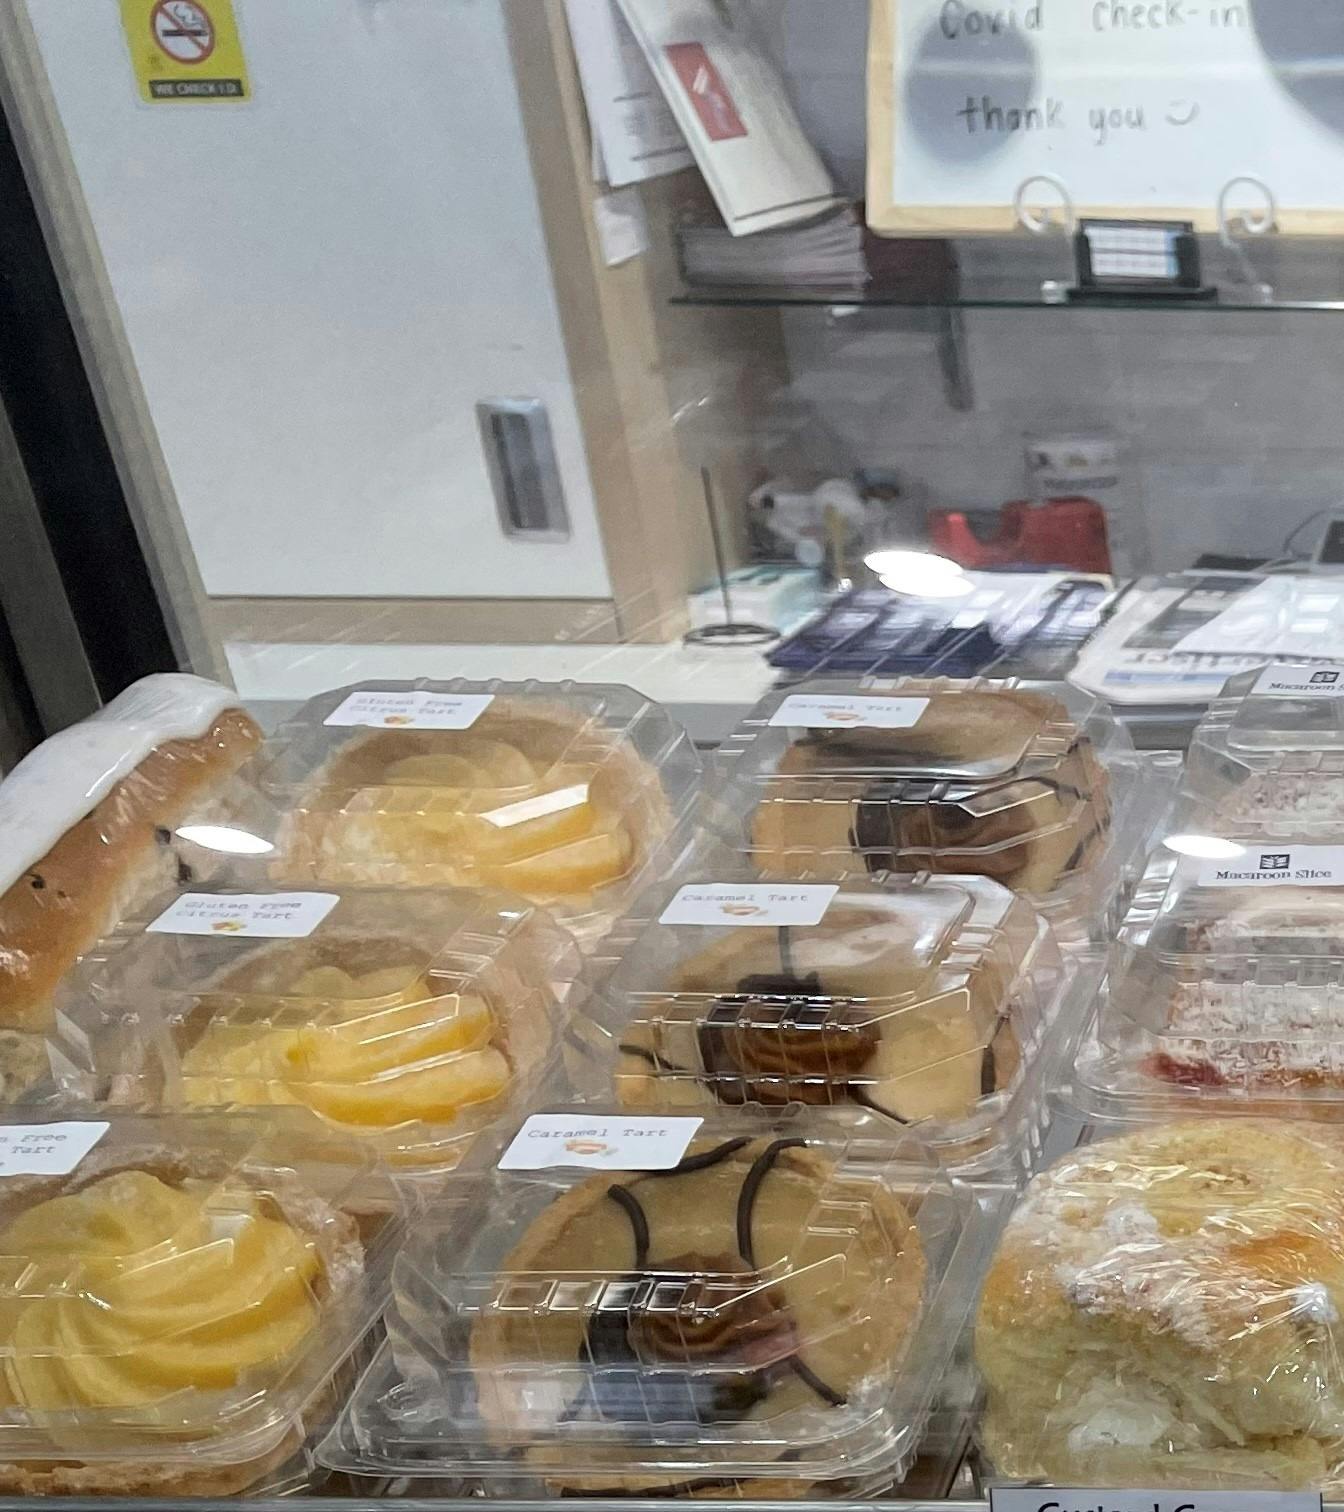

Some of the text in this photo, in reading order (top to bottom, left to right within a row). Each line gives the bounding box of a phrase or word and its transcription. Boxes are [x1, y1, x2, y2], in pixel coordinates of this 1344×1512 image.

[940, 0, 1044, 40] Covid
[956, 95, 1147, 147] thank you
[527, 1128, 668, 1138] Caramel Tart
